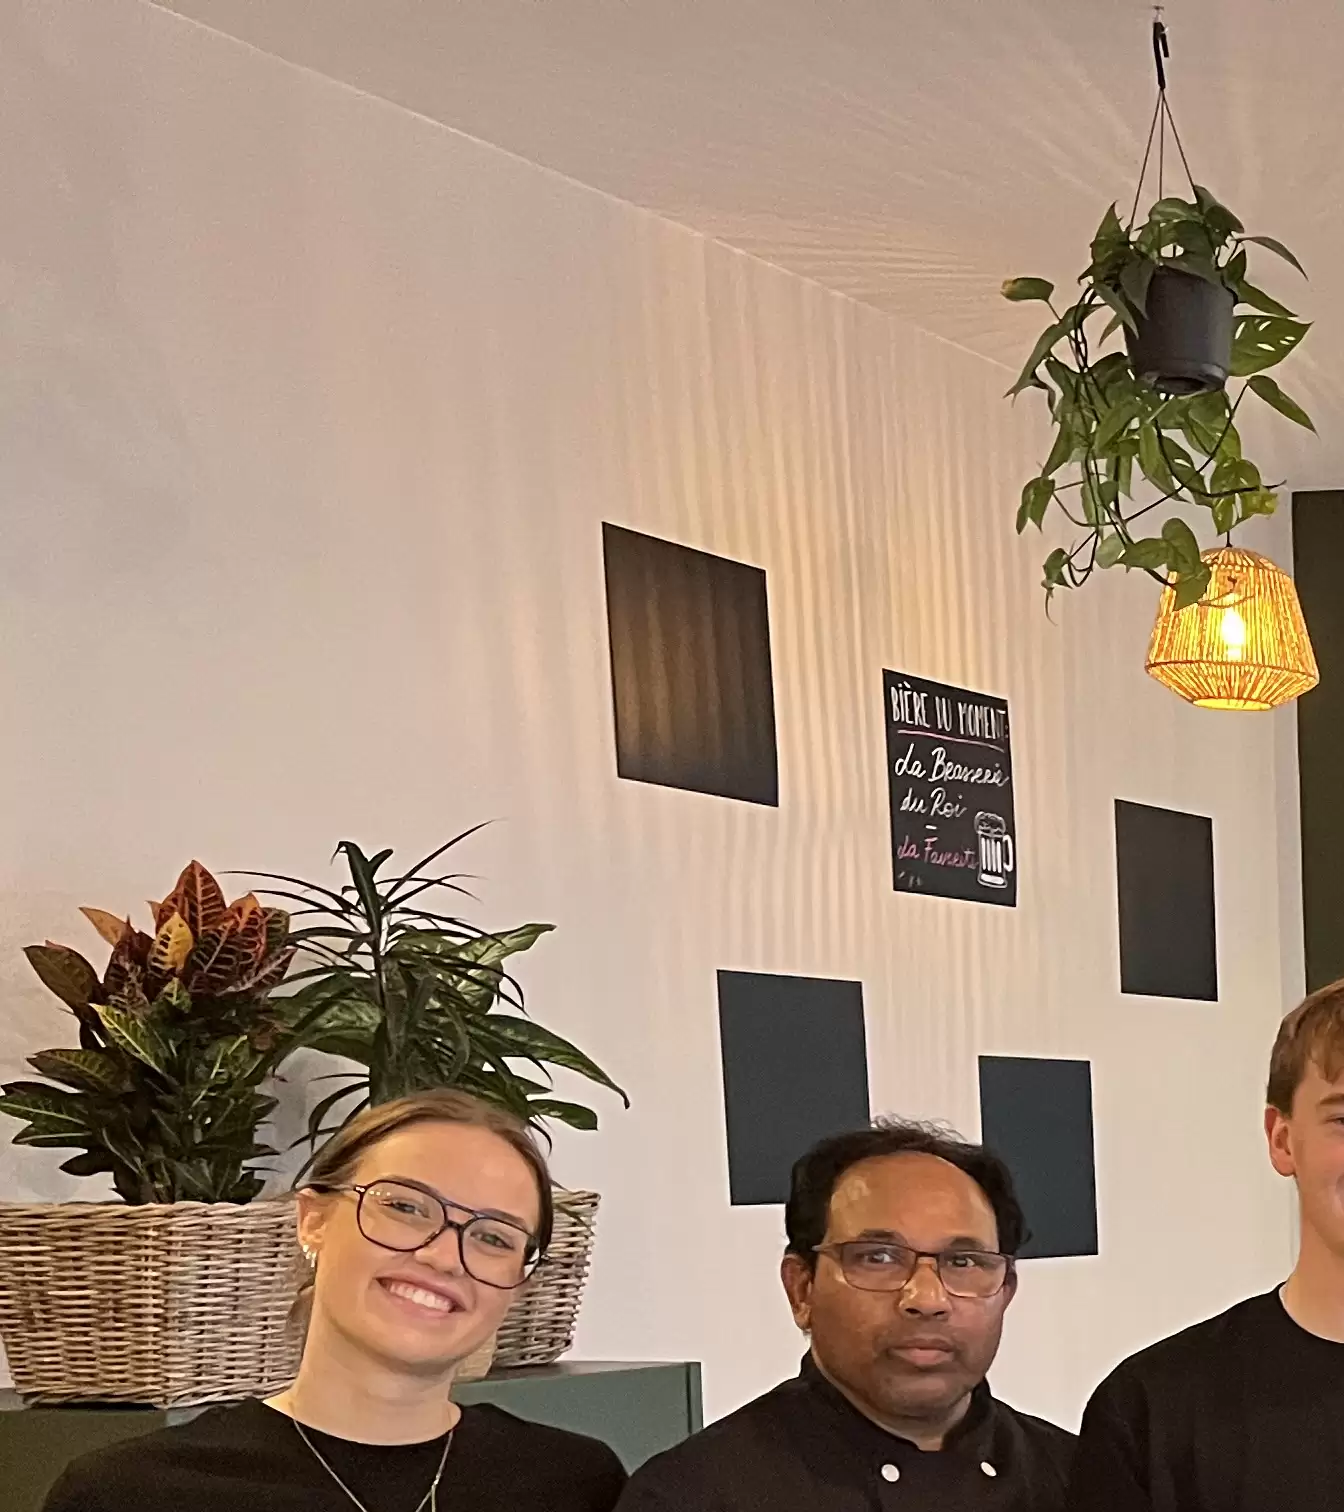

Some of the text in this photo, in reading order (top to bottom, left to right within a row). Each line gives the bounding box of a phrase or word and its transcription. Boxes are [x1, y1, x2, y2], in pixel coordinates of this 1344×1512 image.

[890, 681, 930, 728] BIÈRE
[935, 696, 952, 732] DU
[928, 747, 1010, 787] Brasserie
[930, 787, 967, 818] Roi
